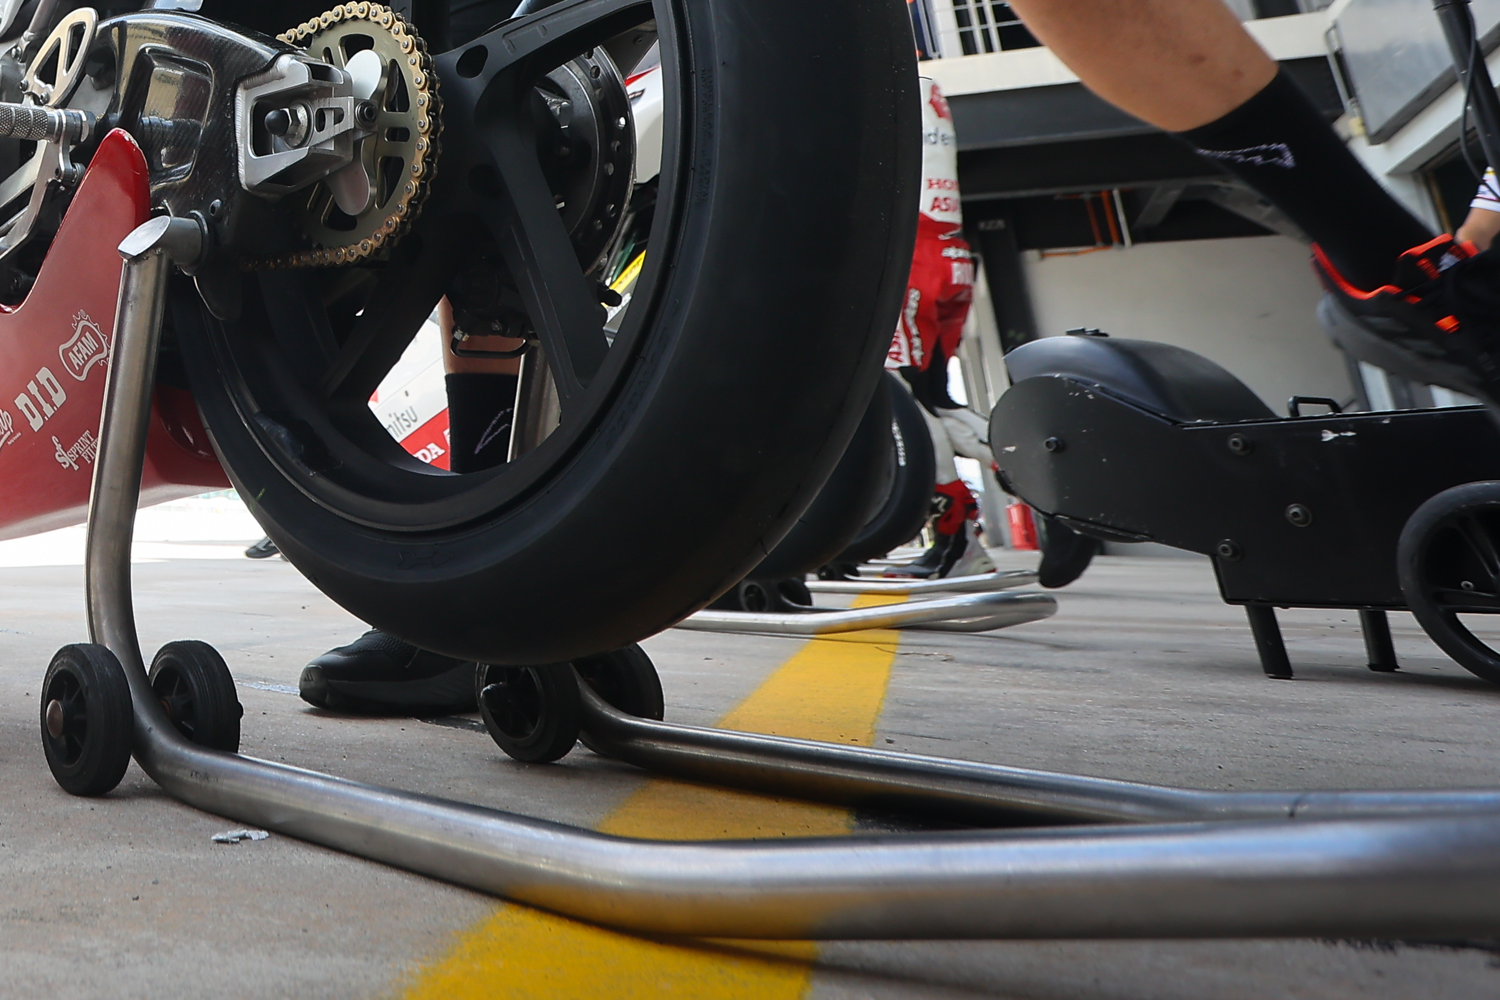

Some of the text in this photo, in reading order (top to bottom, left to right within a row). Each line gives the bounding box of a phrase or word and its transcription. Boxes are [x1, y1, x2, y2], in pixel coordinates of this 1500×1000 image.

[68, 331, 99, 370] AFAM
[66, 429, 96, 463] SPRINT
[81, 437, 100, 465] FILT
